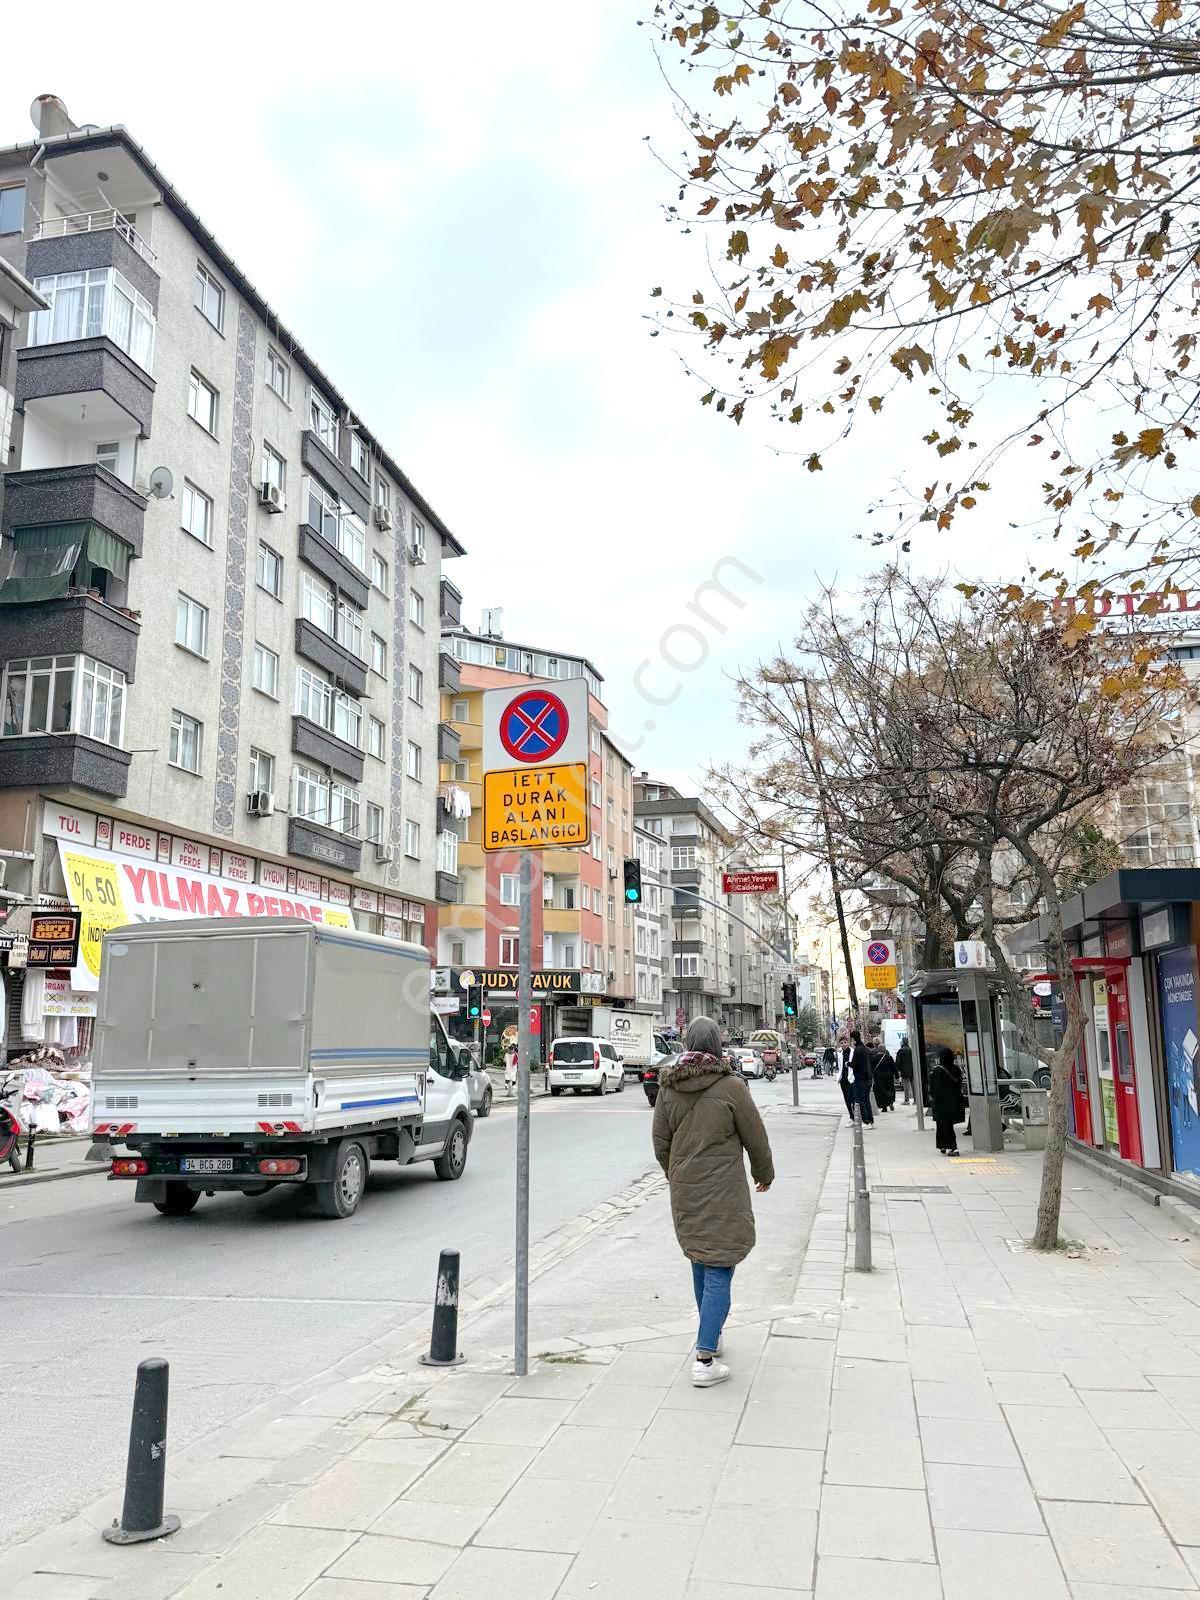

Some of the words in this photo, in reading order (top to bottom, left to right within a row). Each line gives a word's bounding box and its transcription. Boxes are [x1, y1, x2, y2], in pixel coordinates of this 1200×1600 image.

[513, 772, 556, 788] İETT
[503, 789, 567, 807] DURAK
[506, 807, 565, 825] ALANI
[58, 815, 82, 835] TÜL
[119, 830, 151, 851] PERDE
[491, 824, 581, 844] BAŞLANGICI
[183, 843, 199, 854] FON
[180, 854, 202, 869] PERDE
[230, 855, 247, 868] STOR
[228, 867, 248, 881] PERDE
[263, 868, 285, 883] UYGUN
[751, 874, 774, 883] Yesevi
[74, 871, 92, 903] %
[95, 876, 117, 907] 50
[122, 863, 242, 918] YILMAZ
[736, 883, 765, 891] Caddesi
[480, 972, 519, 988] JUDY
[186, 1159, 195, 1170] 34
